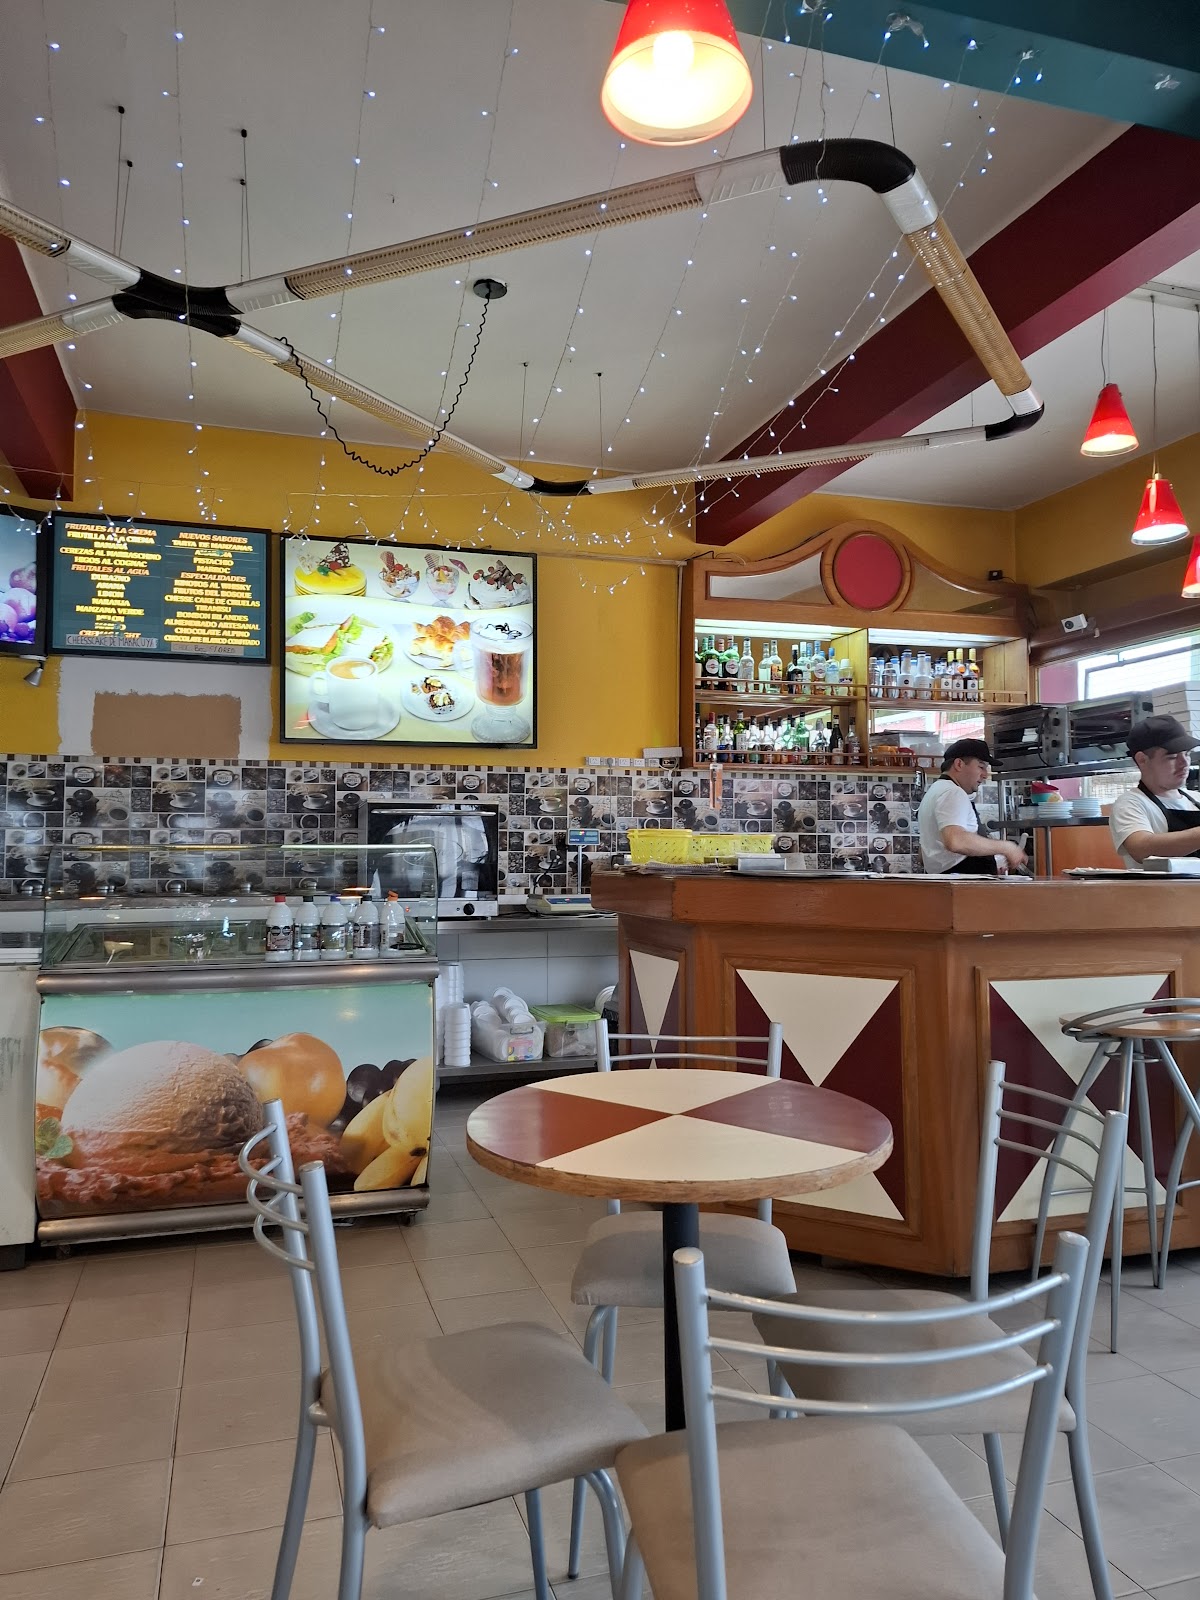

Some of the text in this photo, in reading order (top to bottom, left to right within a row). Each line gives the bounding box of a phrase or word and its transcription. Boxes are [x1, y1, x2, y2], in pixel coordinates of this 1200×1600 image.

[65, 523, 106, 532] FRUTALES
[179, 532, 211, 540] NUEVOS
[71, 564, 112, 572] FRUTALES
[181, 572, 246, 582] ESPECIALIDADES
